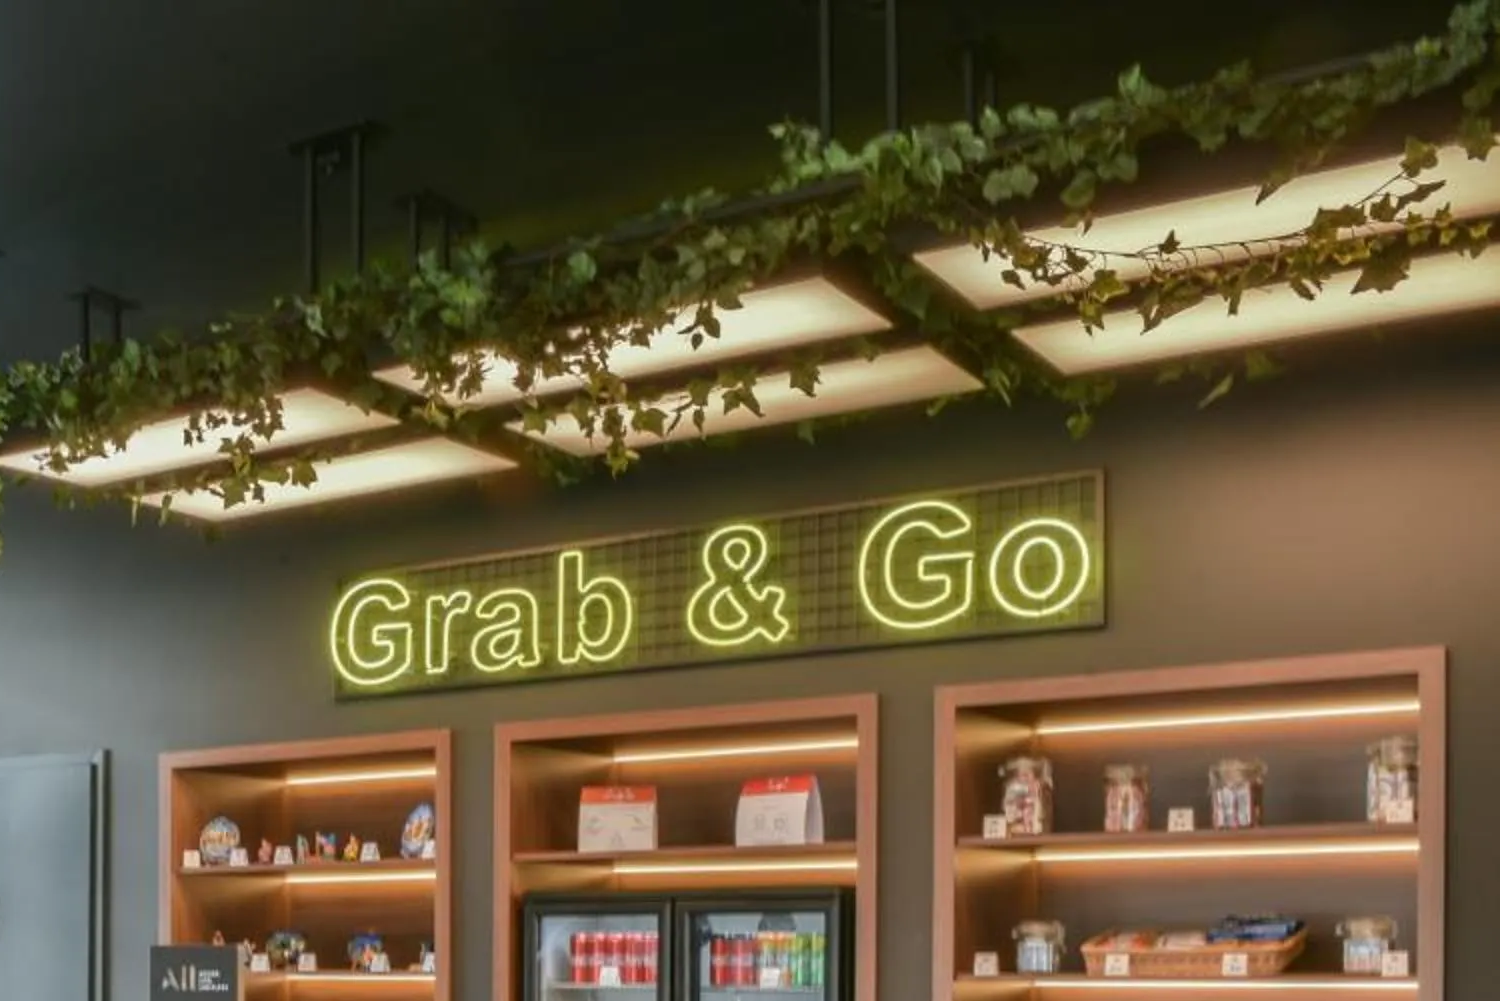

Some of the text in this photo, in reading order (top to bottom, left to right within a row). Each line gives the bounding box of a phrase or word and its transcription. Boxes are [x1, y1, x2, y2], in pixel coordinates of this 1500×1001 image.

[330, 500, 1090, 686] Grab & Go
